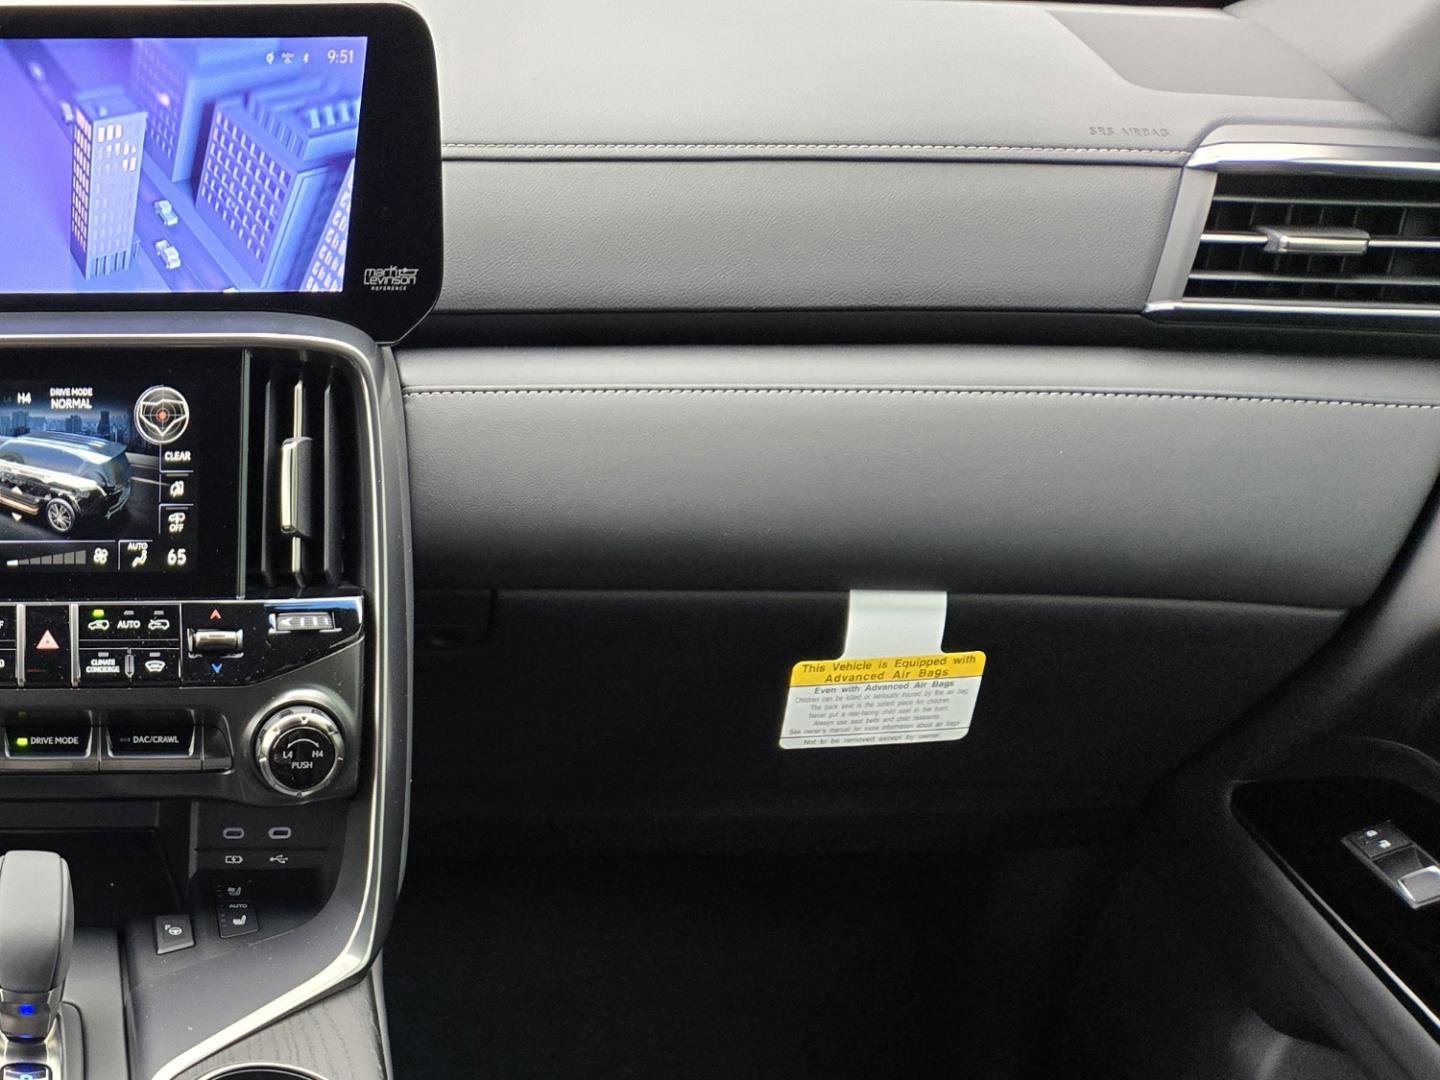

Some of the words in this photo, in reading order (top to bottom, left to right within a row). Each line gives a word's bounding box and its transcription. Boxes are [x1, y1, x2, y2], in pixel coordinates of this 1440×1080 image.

[327, 49, 355, 64] 9:51
[50, 387, 70, 397] DRIVE
[70, 387, 93, 397] MODE
[17, 392, 31, 404] H4
[51, 399, 92, 410] NORMAL
[164, 451, 191, 461] CLEAR
[169, 523, 184, 533] OFF
[127, 542, 148, 551] AUTO
[167, 549, 187, 566] 65
[116, 620, 141, 629] AUTO
[90, 658, 116, 666] CLIMATE
[802, 664, 826, 673] This
[832, 661, 872, 671] Vehicle
[878, 661, 888, 669] is
[895, 657, 948, 668] Equipped
[953, 655, 976, 665] with
[824, 672, 885, 683] Advanced
[893, 670, 911, 679] Air
[919, 669, 949, 678] Bags
[814, 687, 837, 695] Even
[865, 682, 909, 691] Advanced
[913, 681, 927, 689] Air
[931, 681, 955, 689] Bags
[30, 736, 56, 745] DRIVE
[57, 736, 79, 745] MODE
[132, 735, 179, 744] DAC/CRAWL
[311, 749, 324, 758] H4
[291, 761, 313, 769] PUSH
